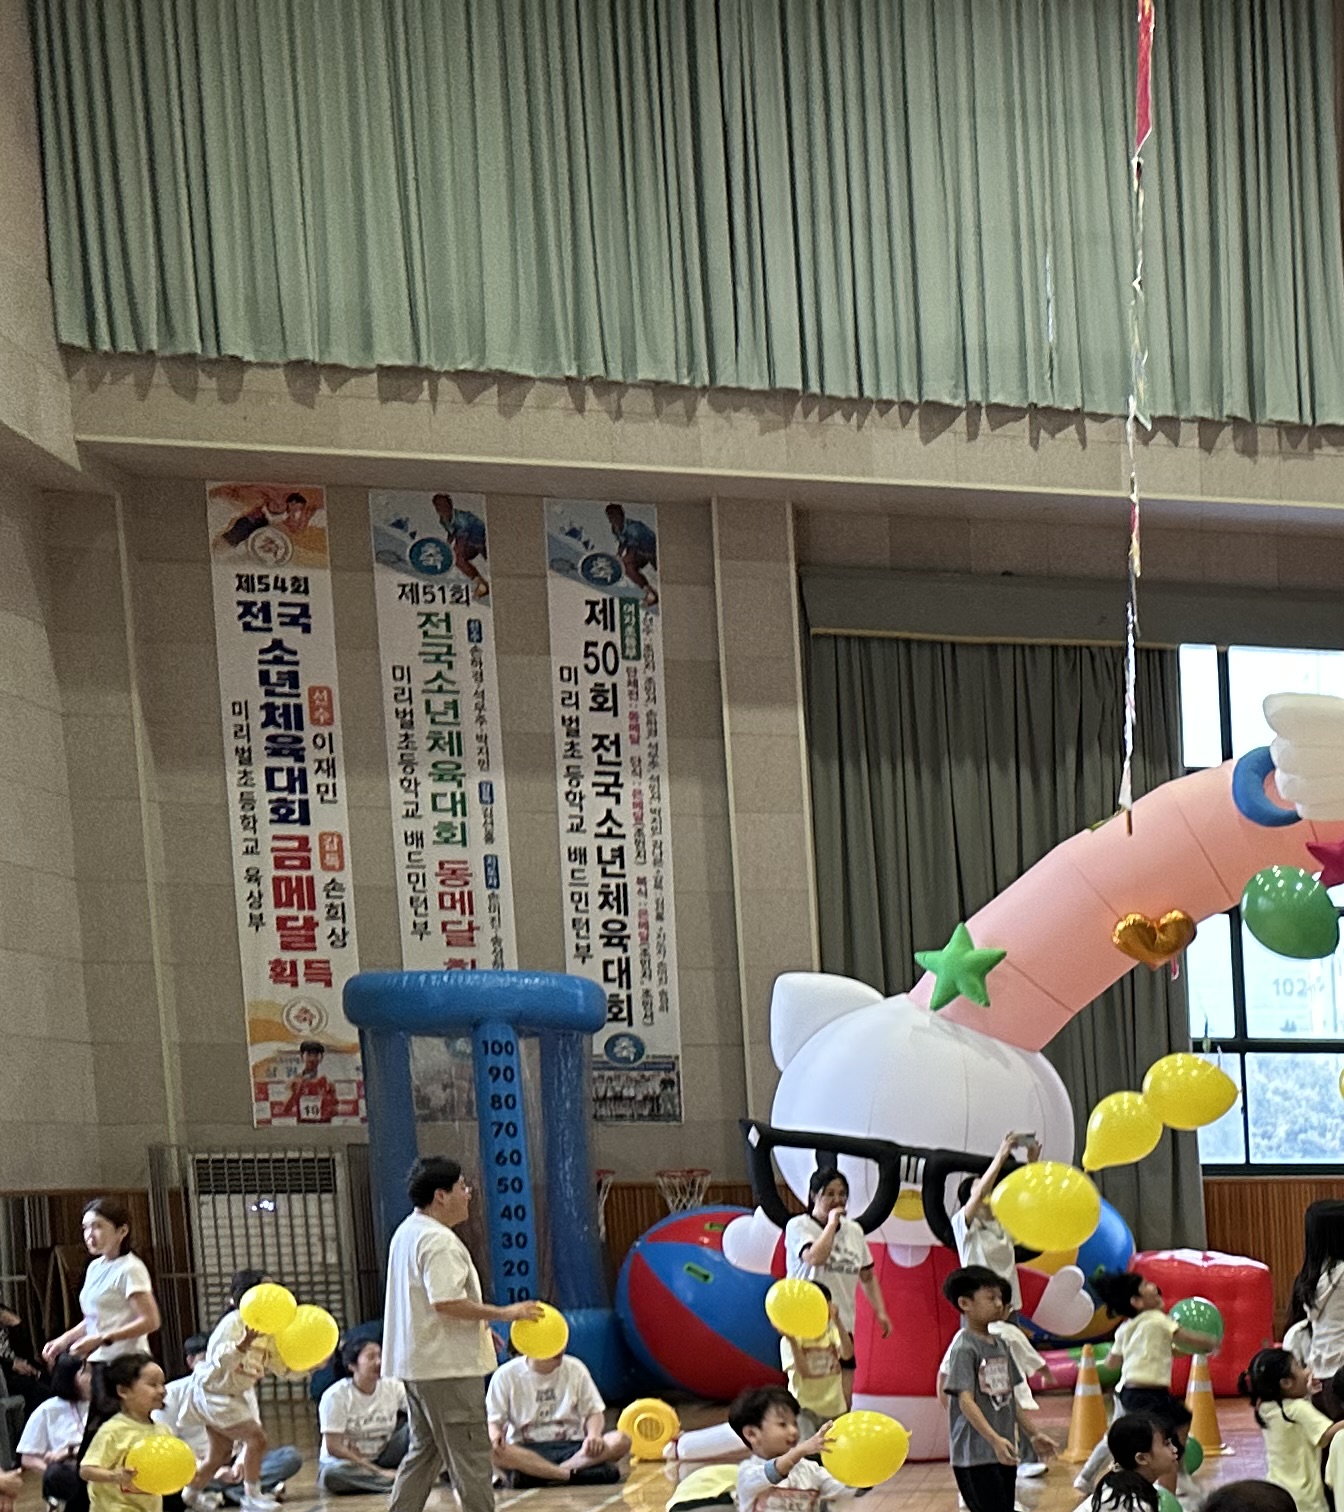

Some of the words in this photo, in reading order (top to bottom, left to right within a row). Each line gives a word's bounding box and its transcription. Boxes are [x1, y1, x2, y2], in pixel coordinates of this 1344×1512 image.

[235, 573, 310, 595] 제54회
[397, 582, 471, 607] 제51회
[236, 599, 311, 634] 전국
[257, 638, 311, 826] 소년체육대회
[391, 664, 423, 819] 미리벌초등학교
[416, 610, 467, 848] 전국소년체육대회
[559, 665, 587, 834] 미리벌초등학교
[231, 699, 260, 856] 미리벌초등학교
[311, 731, 338, 805] 이재민
[270, 834, 319, 951] 금메달
[403, 829, 432, 942] 배드민턴부
[591, 732, 634, 1028] 전국소년체육대회
[243, 866, 266, 934] 육상부
[434, 859, 480, 948] 동메달
[567, 846, 593, 965] 배드민턴부
[269, 958, 332, 988] 획득
[482, 1040, 514, 1057] 100
[488, 1066, 515, 1083] 90
[490, 1094, 517, 1111] 80
[491, 1121, 518, 1139] 70
[495, 1149, 522, 1167] 60
[497, 1177, 523, 1194] 50
[501, 1204, 527, 1222] 40
[501, 1231, 527, 1249] 30
[503, 1260, 529, 1277] 20
